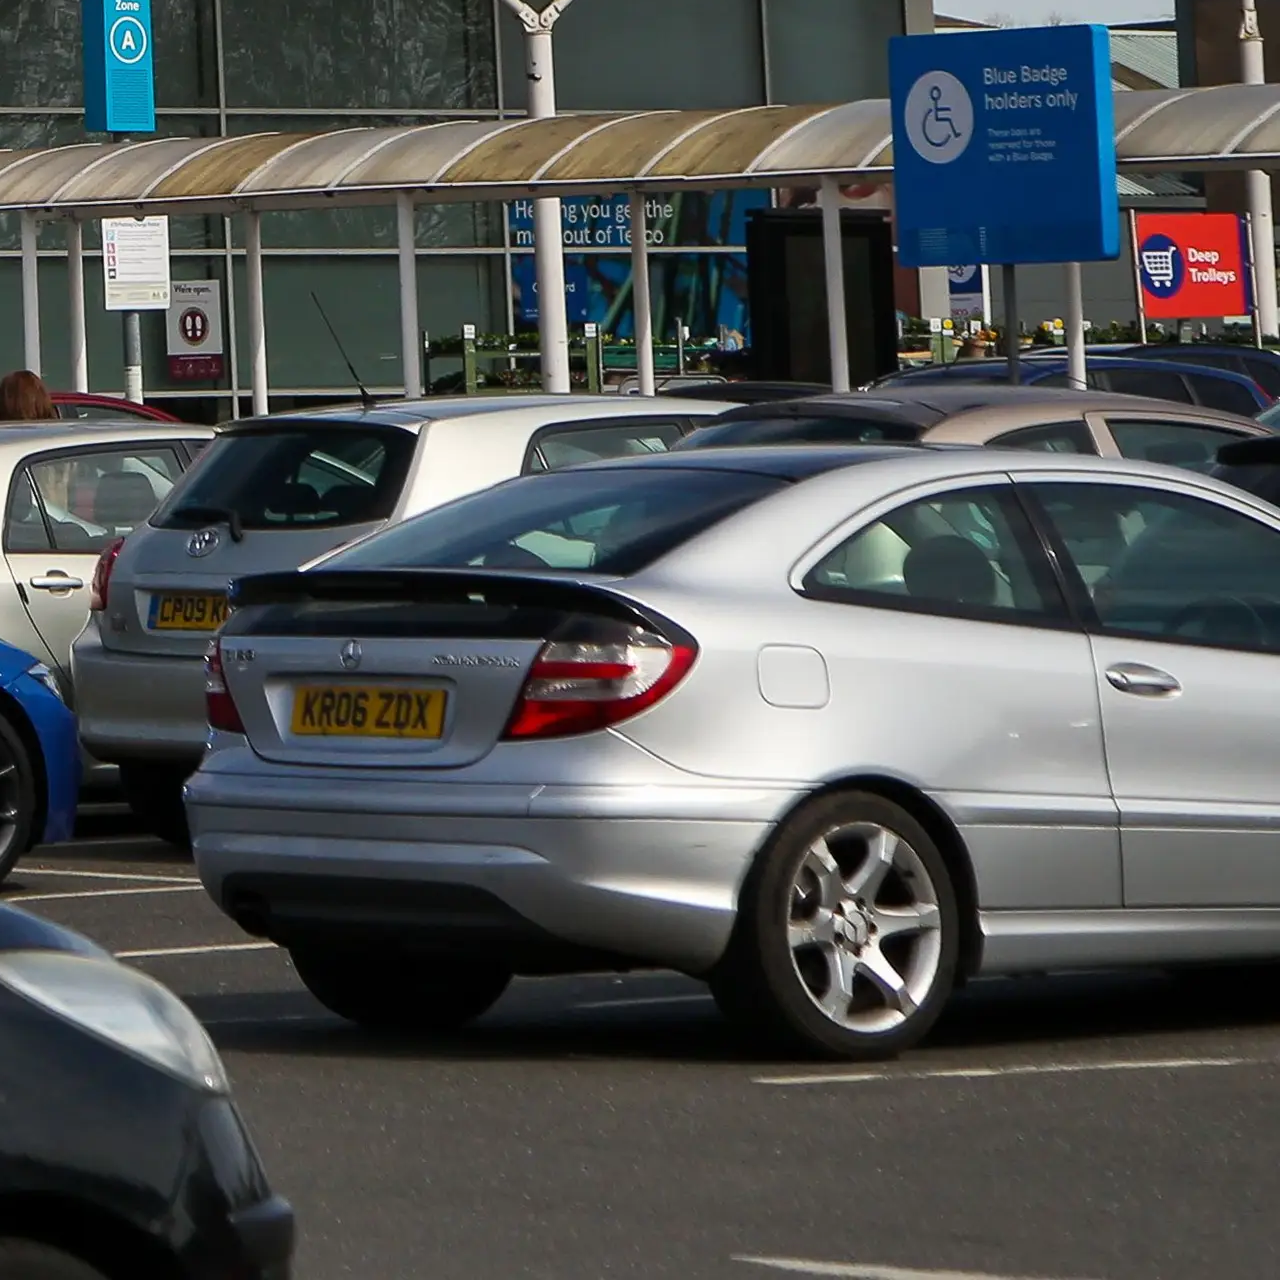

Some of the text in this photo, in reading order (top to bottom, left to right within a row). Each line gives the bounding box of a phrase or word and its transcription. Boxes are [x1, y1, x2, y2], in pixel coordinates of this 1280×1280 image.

[115, 0, 139, 11] Zone
[121, 30, 136, 50] A
[983, 64, 1067, 87] Blue Badge
[984, 88, 1079, 111] holders only
[581, 204, 610, 223] you
[646, 200, 673, 218] the
[563, 226, 664, 244] out of Teco
[1187, 247, 1219, 265] Deep
[1188, 267, 1236, 285] Trolleys
[159, 594, 207, 622] CP09
[301, 689, 432, 731] KR06 ZDX
